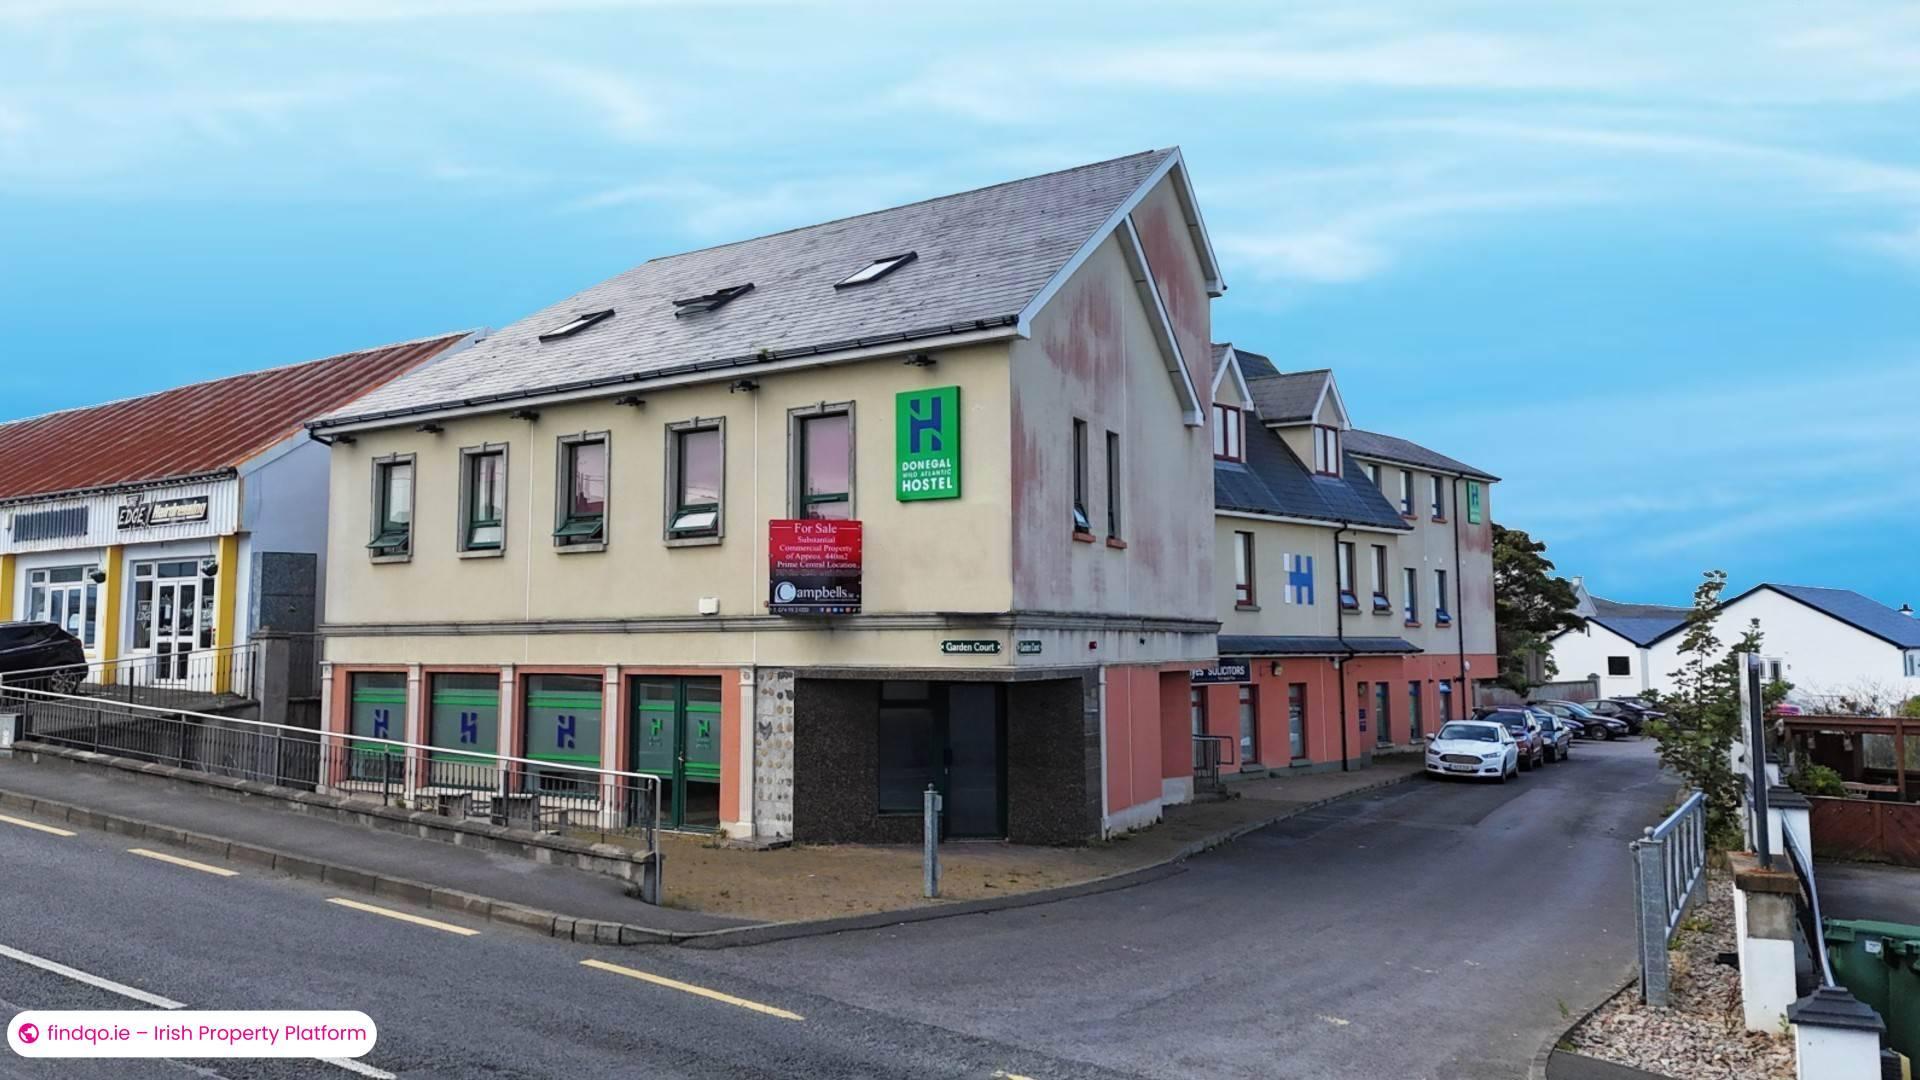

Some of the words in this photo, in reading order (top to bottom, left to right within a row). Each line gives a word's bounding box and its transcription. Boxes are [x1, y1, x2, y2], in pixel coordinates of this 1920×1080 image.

[902, 459, 952, 471] DONEGAL
[921, 469, 952, 478] ATLANTIC
[902, 477, 953, 493] HOSTEL
[119, 507, 147, 526] EDGE
[794, 523, 813, 534] For
[815, 523, 838, 534] Sale
[798, 536, 836, 544] Substantial
[779, 544, 822, 552] Commercial
[824, 544, 853, 554] Property
[785, 553, 794, 561] of
[777, 561, 799, 569] Prime
[800, 561, 825, 569] Central
[946, 642, 973, 652] Garden
[974, 642, 995, 652] Court
